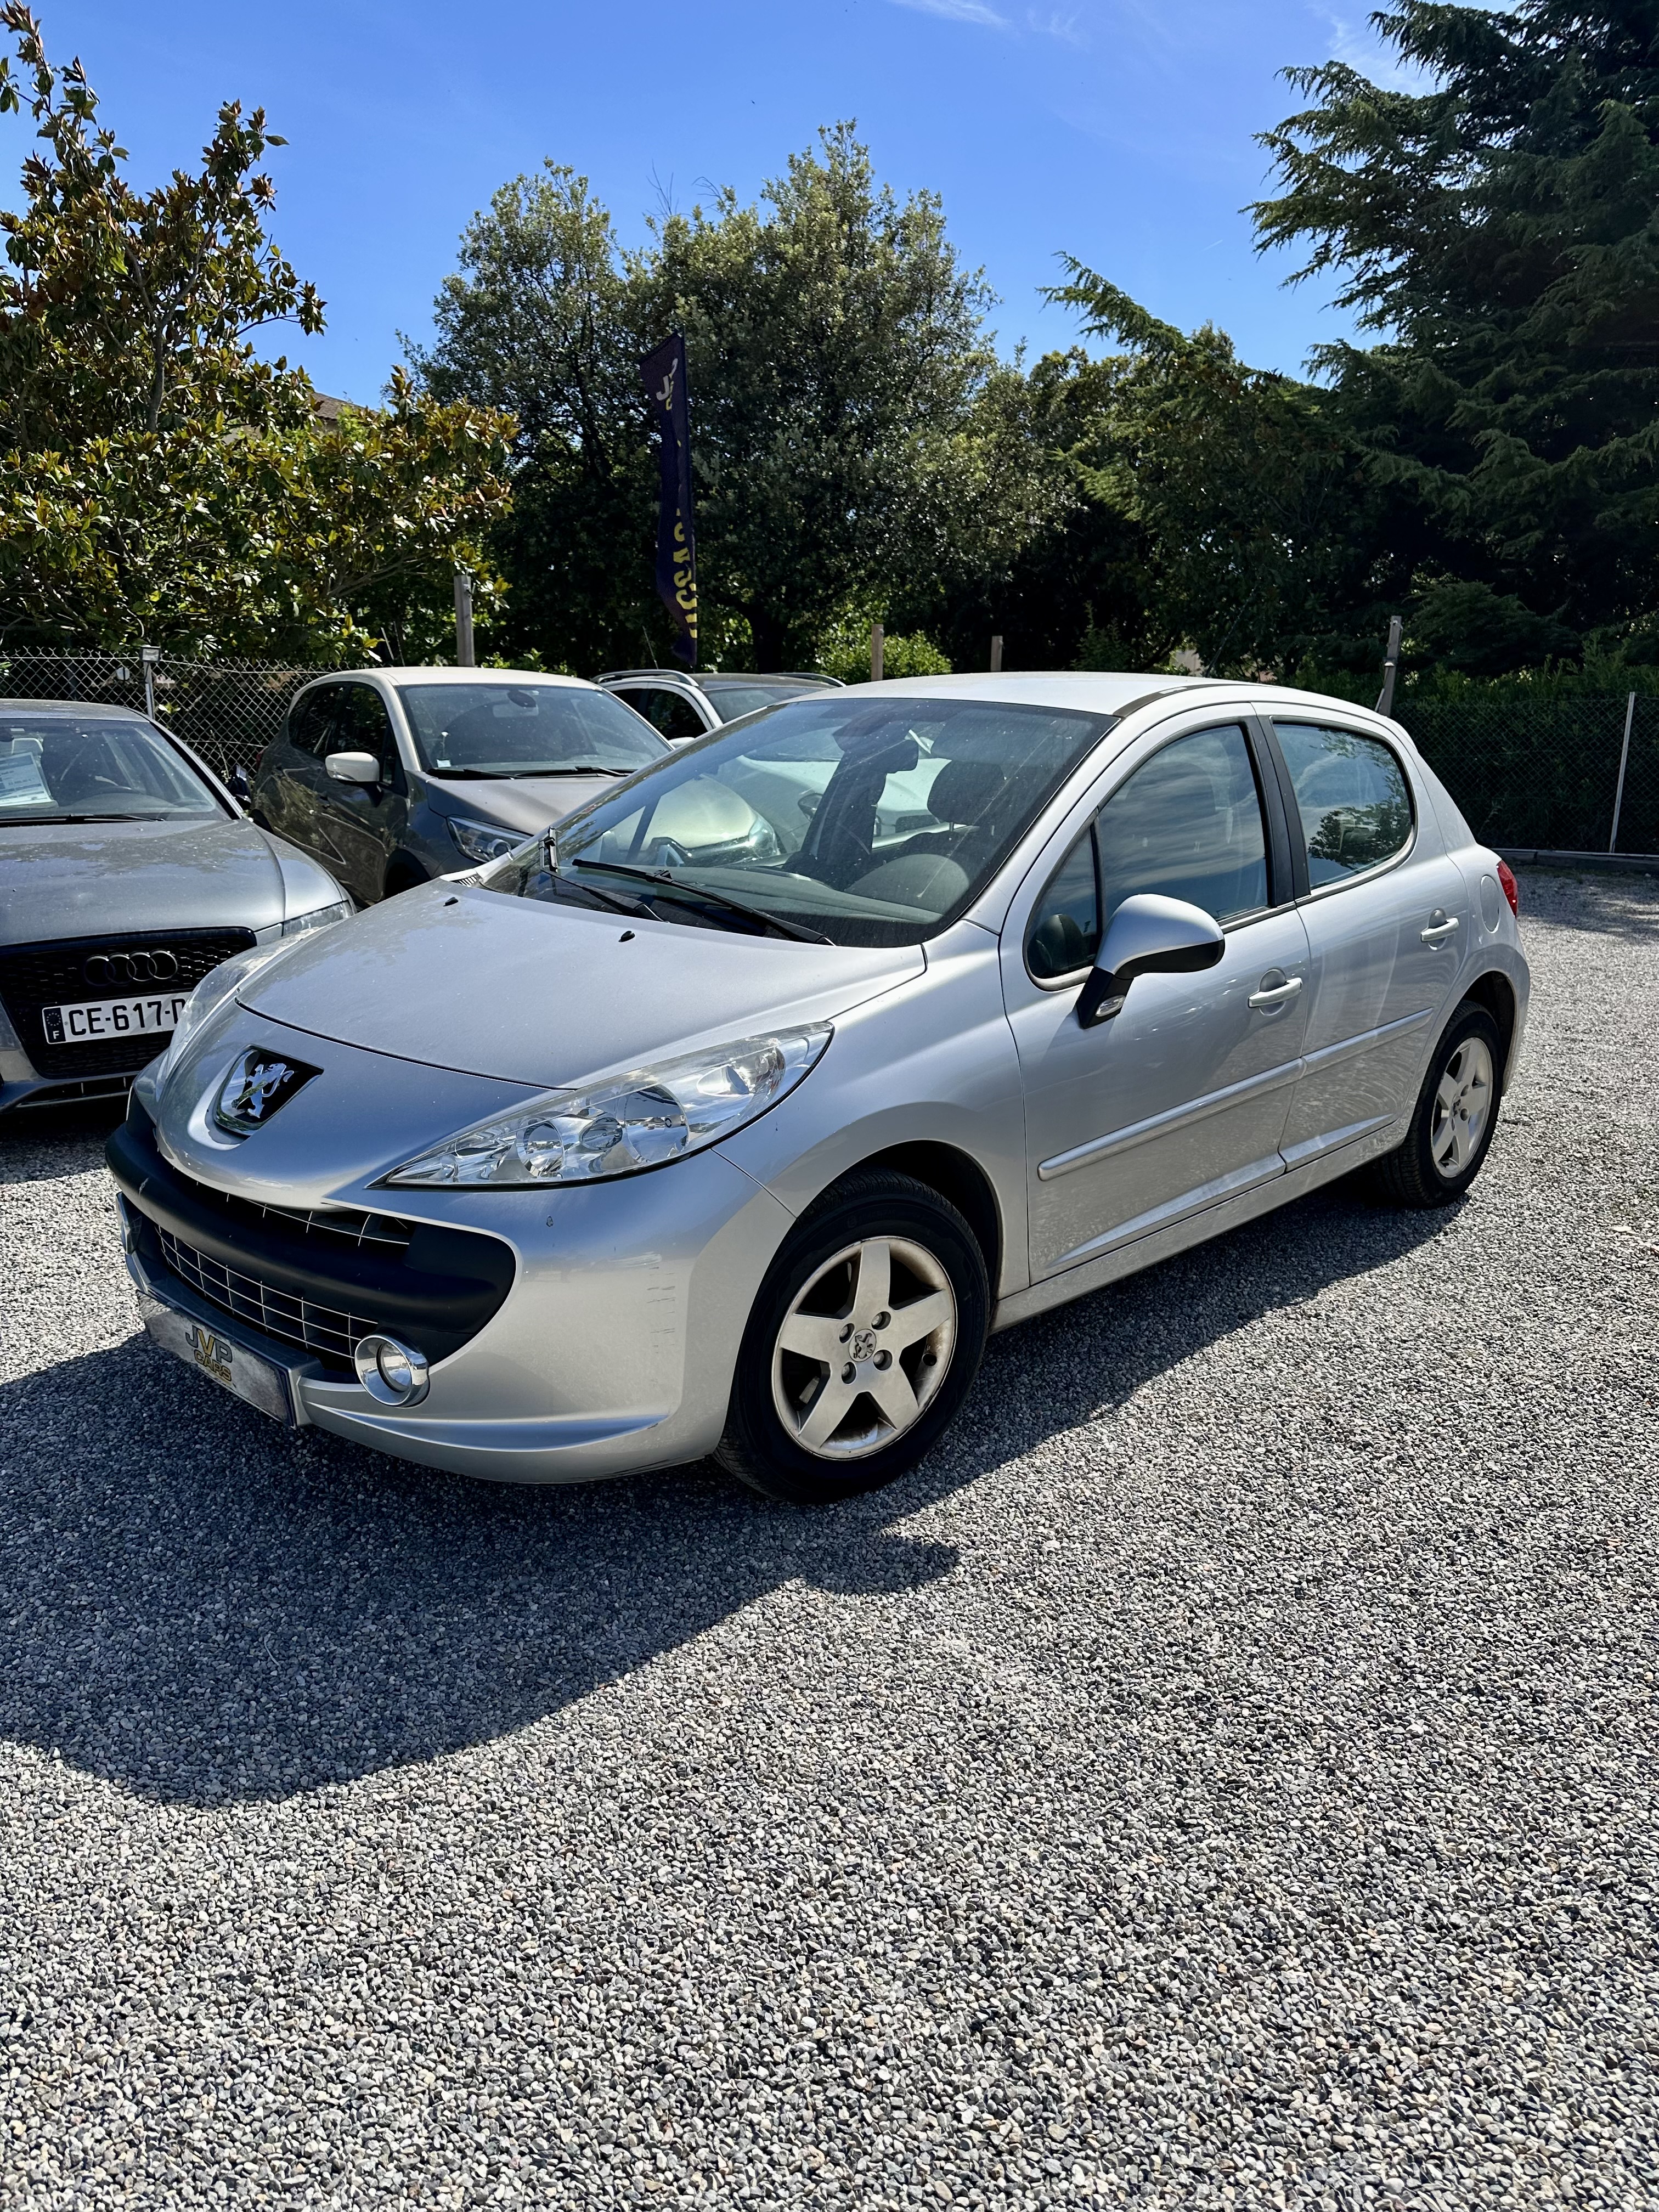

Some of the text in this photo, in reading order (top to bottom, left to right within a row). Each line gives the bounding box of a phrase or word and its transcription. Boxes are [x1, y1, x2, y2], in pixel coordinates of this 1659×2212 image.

[53, 1030, 60, 1039] F
[185, 1325, 233, 1363] JVP
[194, 1349, 232, 1381] CARS
